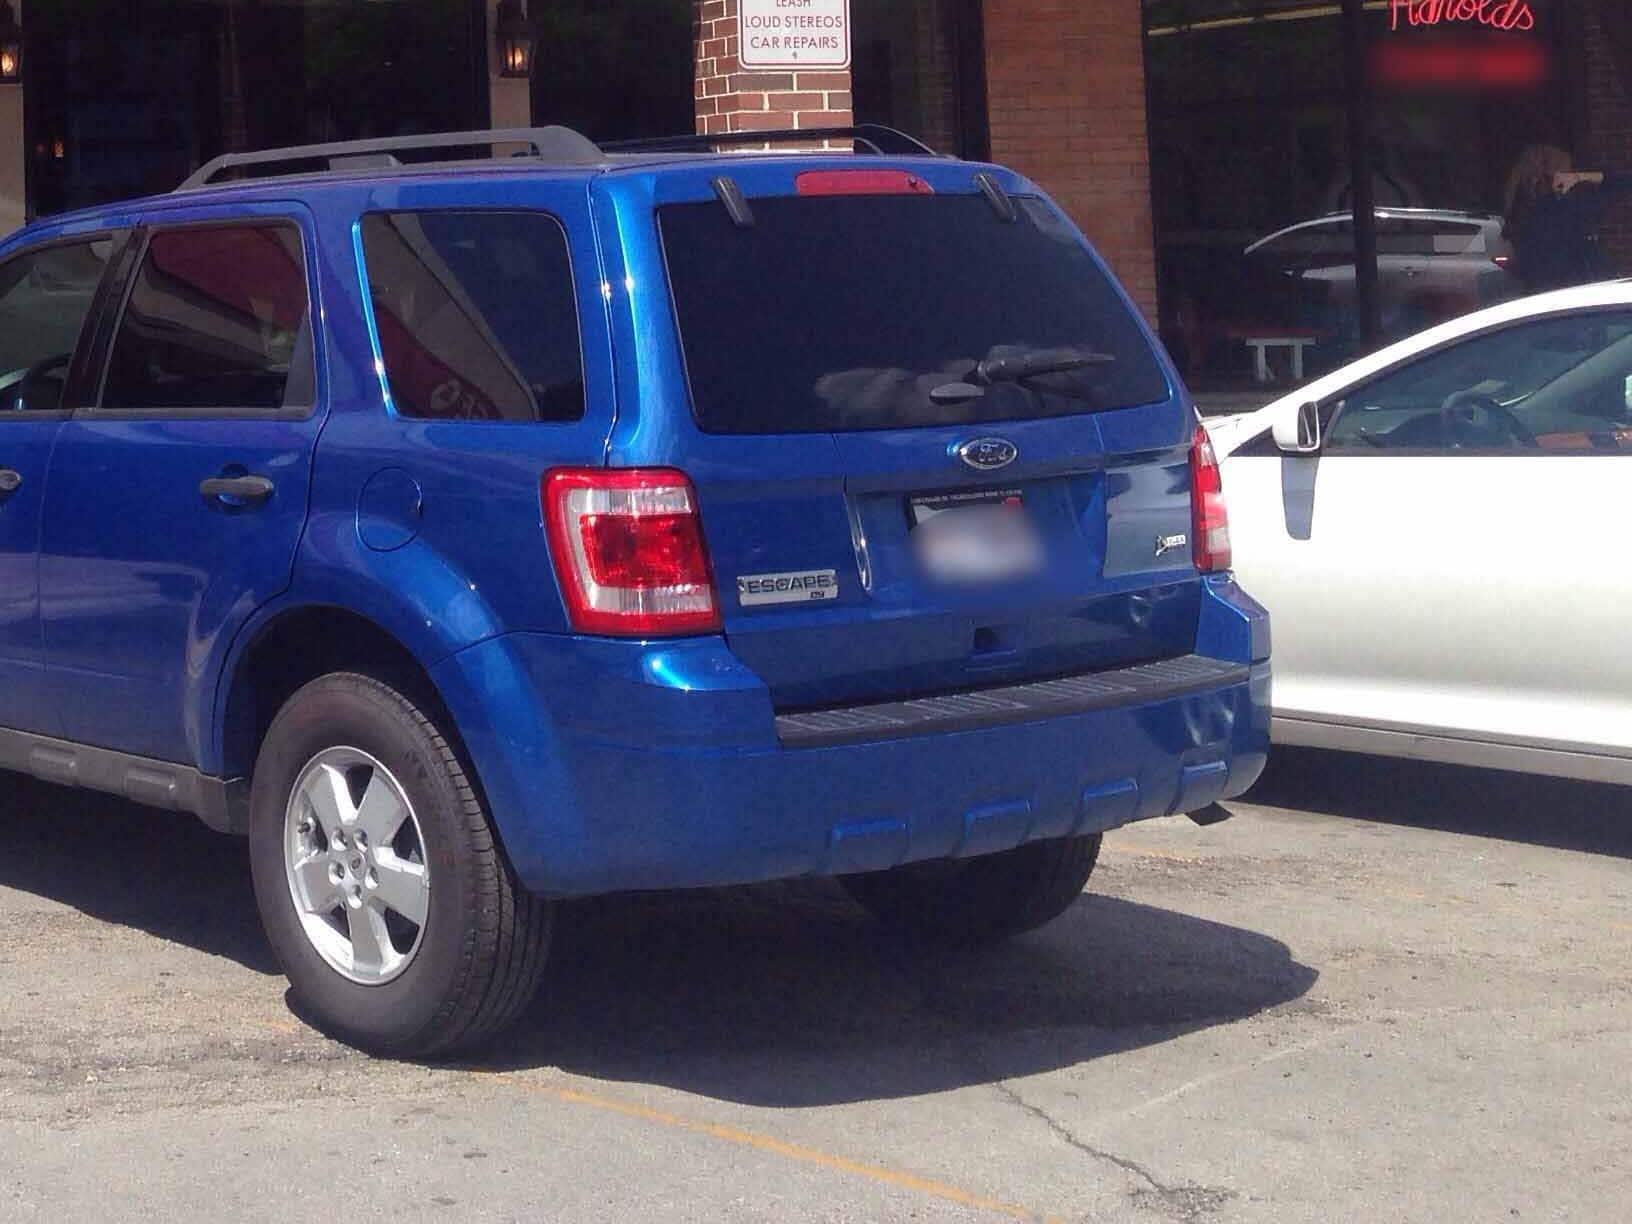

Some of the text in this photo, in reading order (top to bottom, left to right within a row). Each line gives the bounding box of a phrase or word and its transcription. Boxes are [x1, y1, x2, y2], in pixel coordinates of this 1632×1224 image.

[745, 16, 843, 28] LOUD STEREOS
[750, 36, 839, 49] CAR REPAIRS
[747, 574, 832, 594] ESCAPE
